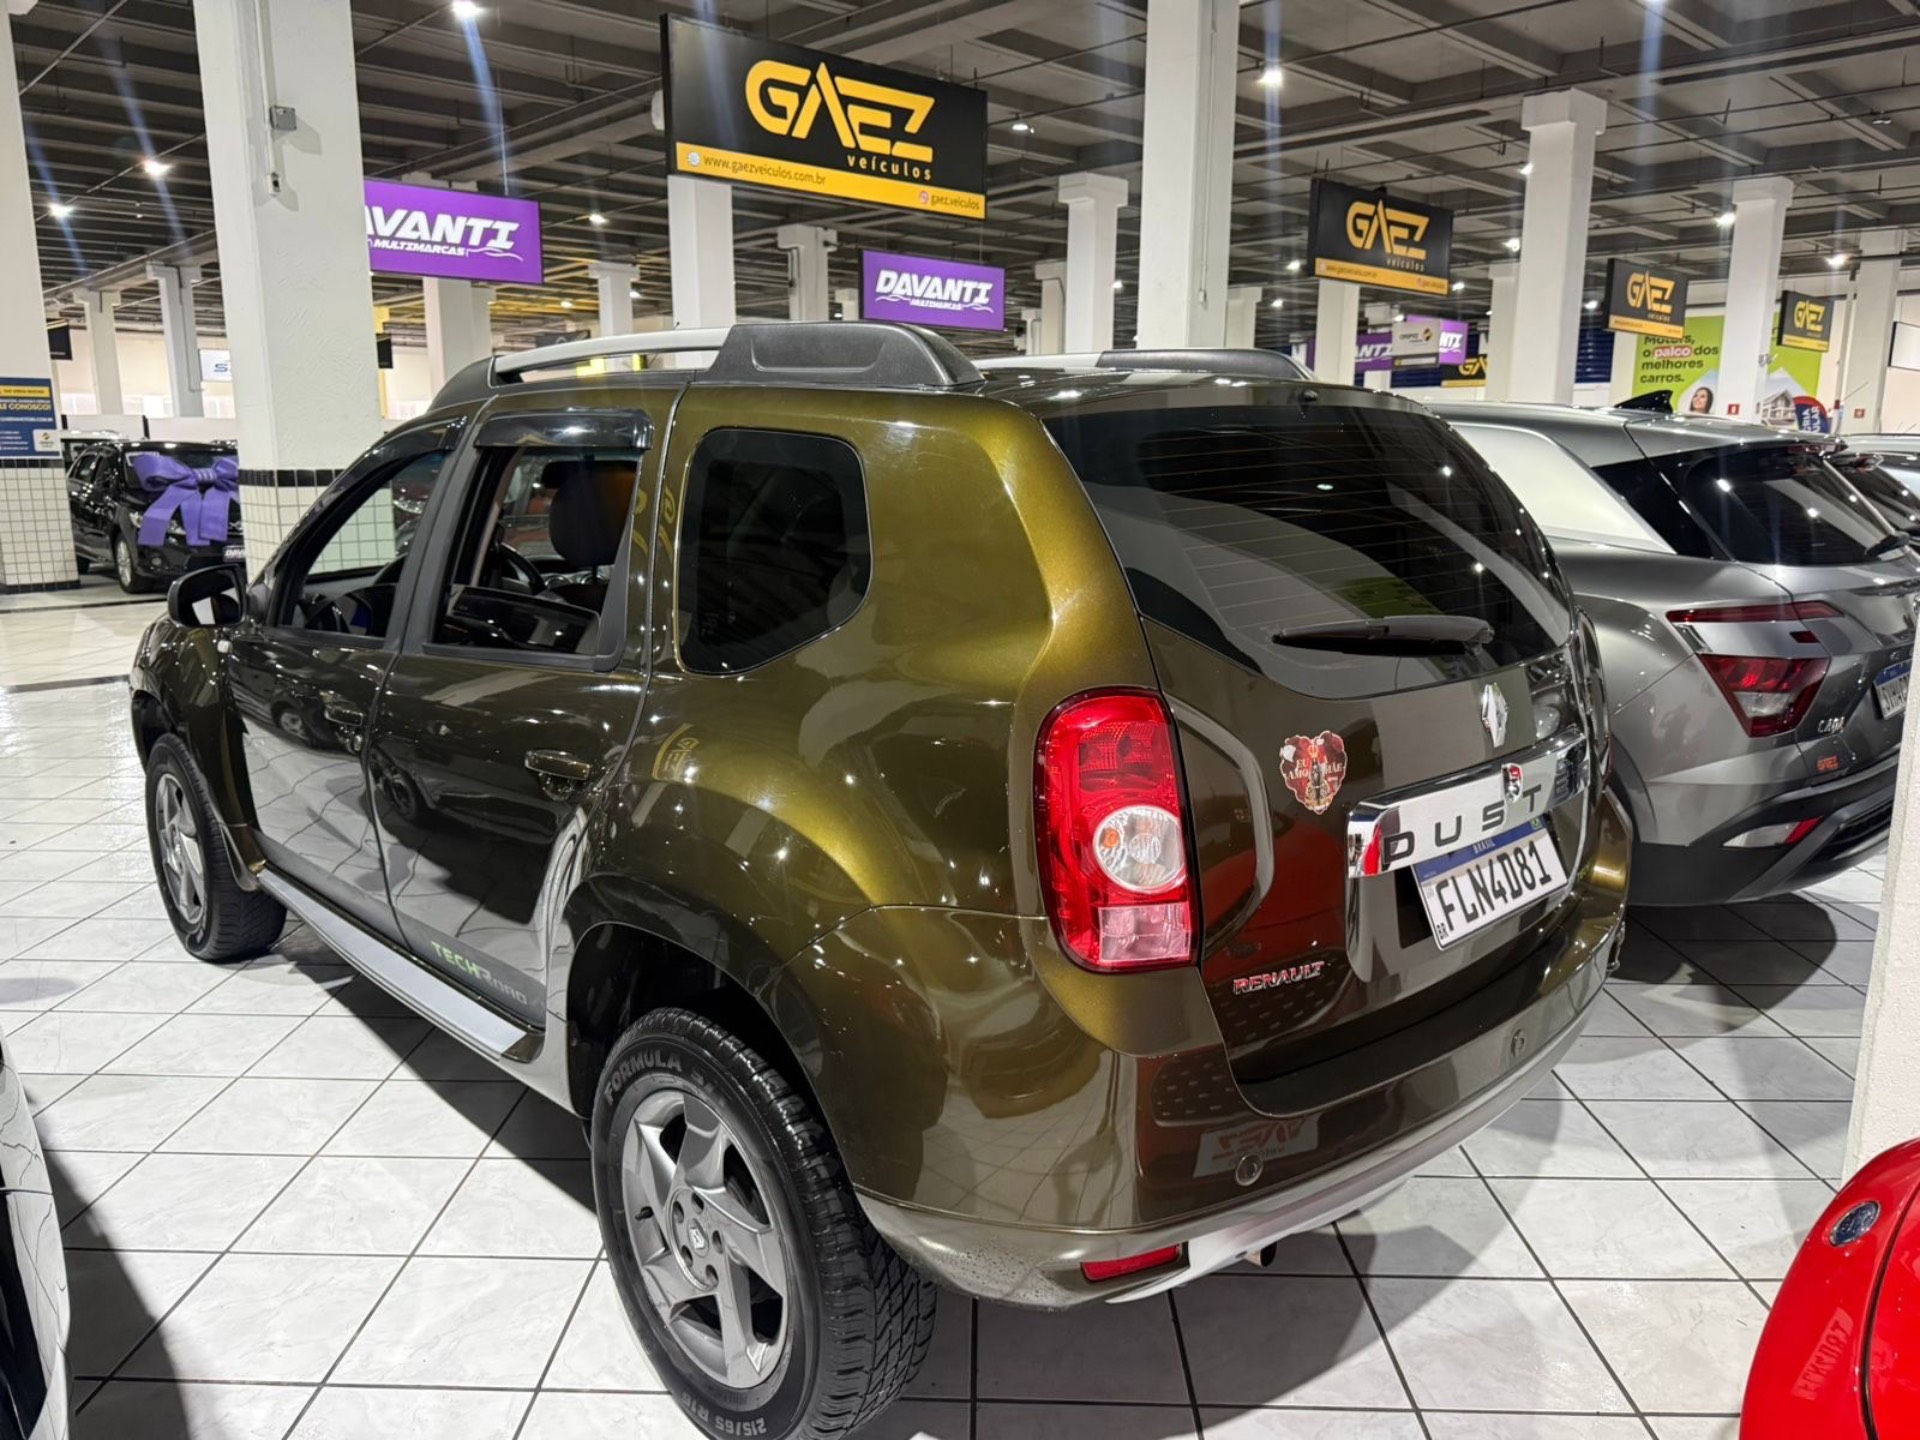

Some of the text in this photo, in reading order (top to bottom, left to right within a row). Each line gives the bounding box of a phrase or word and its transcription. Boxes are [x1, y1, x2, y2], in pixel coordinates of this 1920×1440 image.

[745, 60, 935, 163] GAEZ
[703, 155, 826, 186] www.gaezveiculos.com.br
[847, 154, 932, 181] veículos
[365, 205, 519, 249] VANTI
[1346, 199, 1429, 260] GAEZ
[374, 239, 465, 256] MULTIMARCAS
[875, 269, 993, 304] DAVANTI
[1626, 271, 1675, 314] GAEZ
[1641, 359, 1704, 370] melhores
[1654, 346, 1691, 359] palco
[1694, 345, 1719, 356] dos
[1640, 374, 1685, 384] carros.
[1472, 837, 1496, 855] BRASIL
[1436, 840, 1552, 931] FLN4D81
[1233, 960, 1325, 995] RENAULT
[605, 1049, 682, 1106] FORMULA
